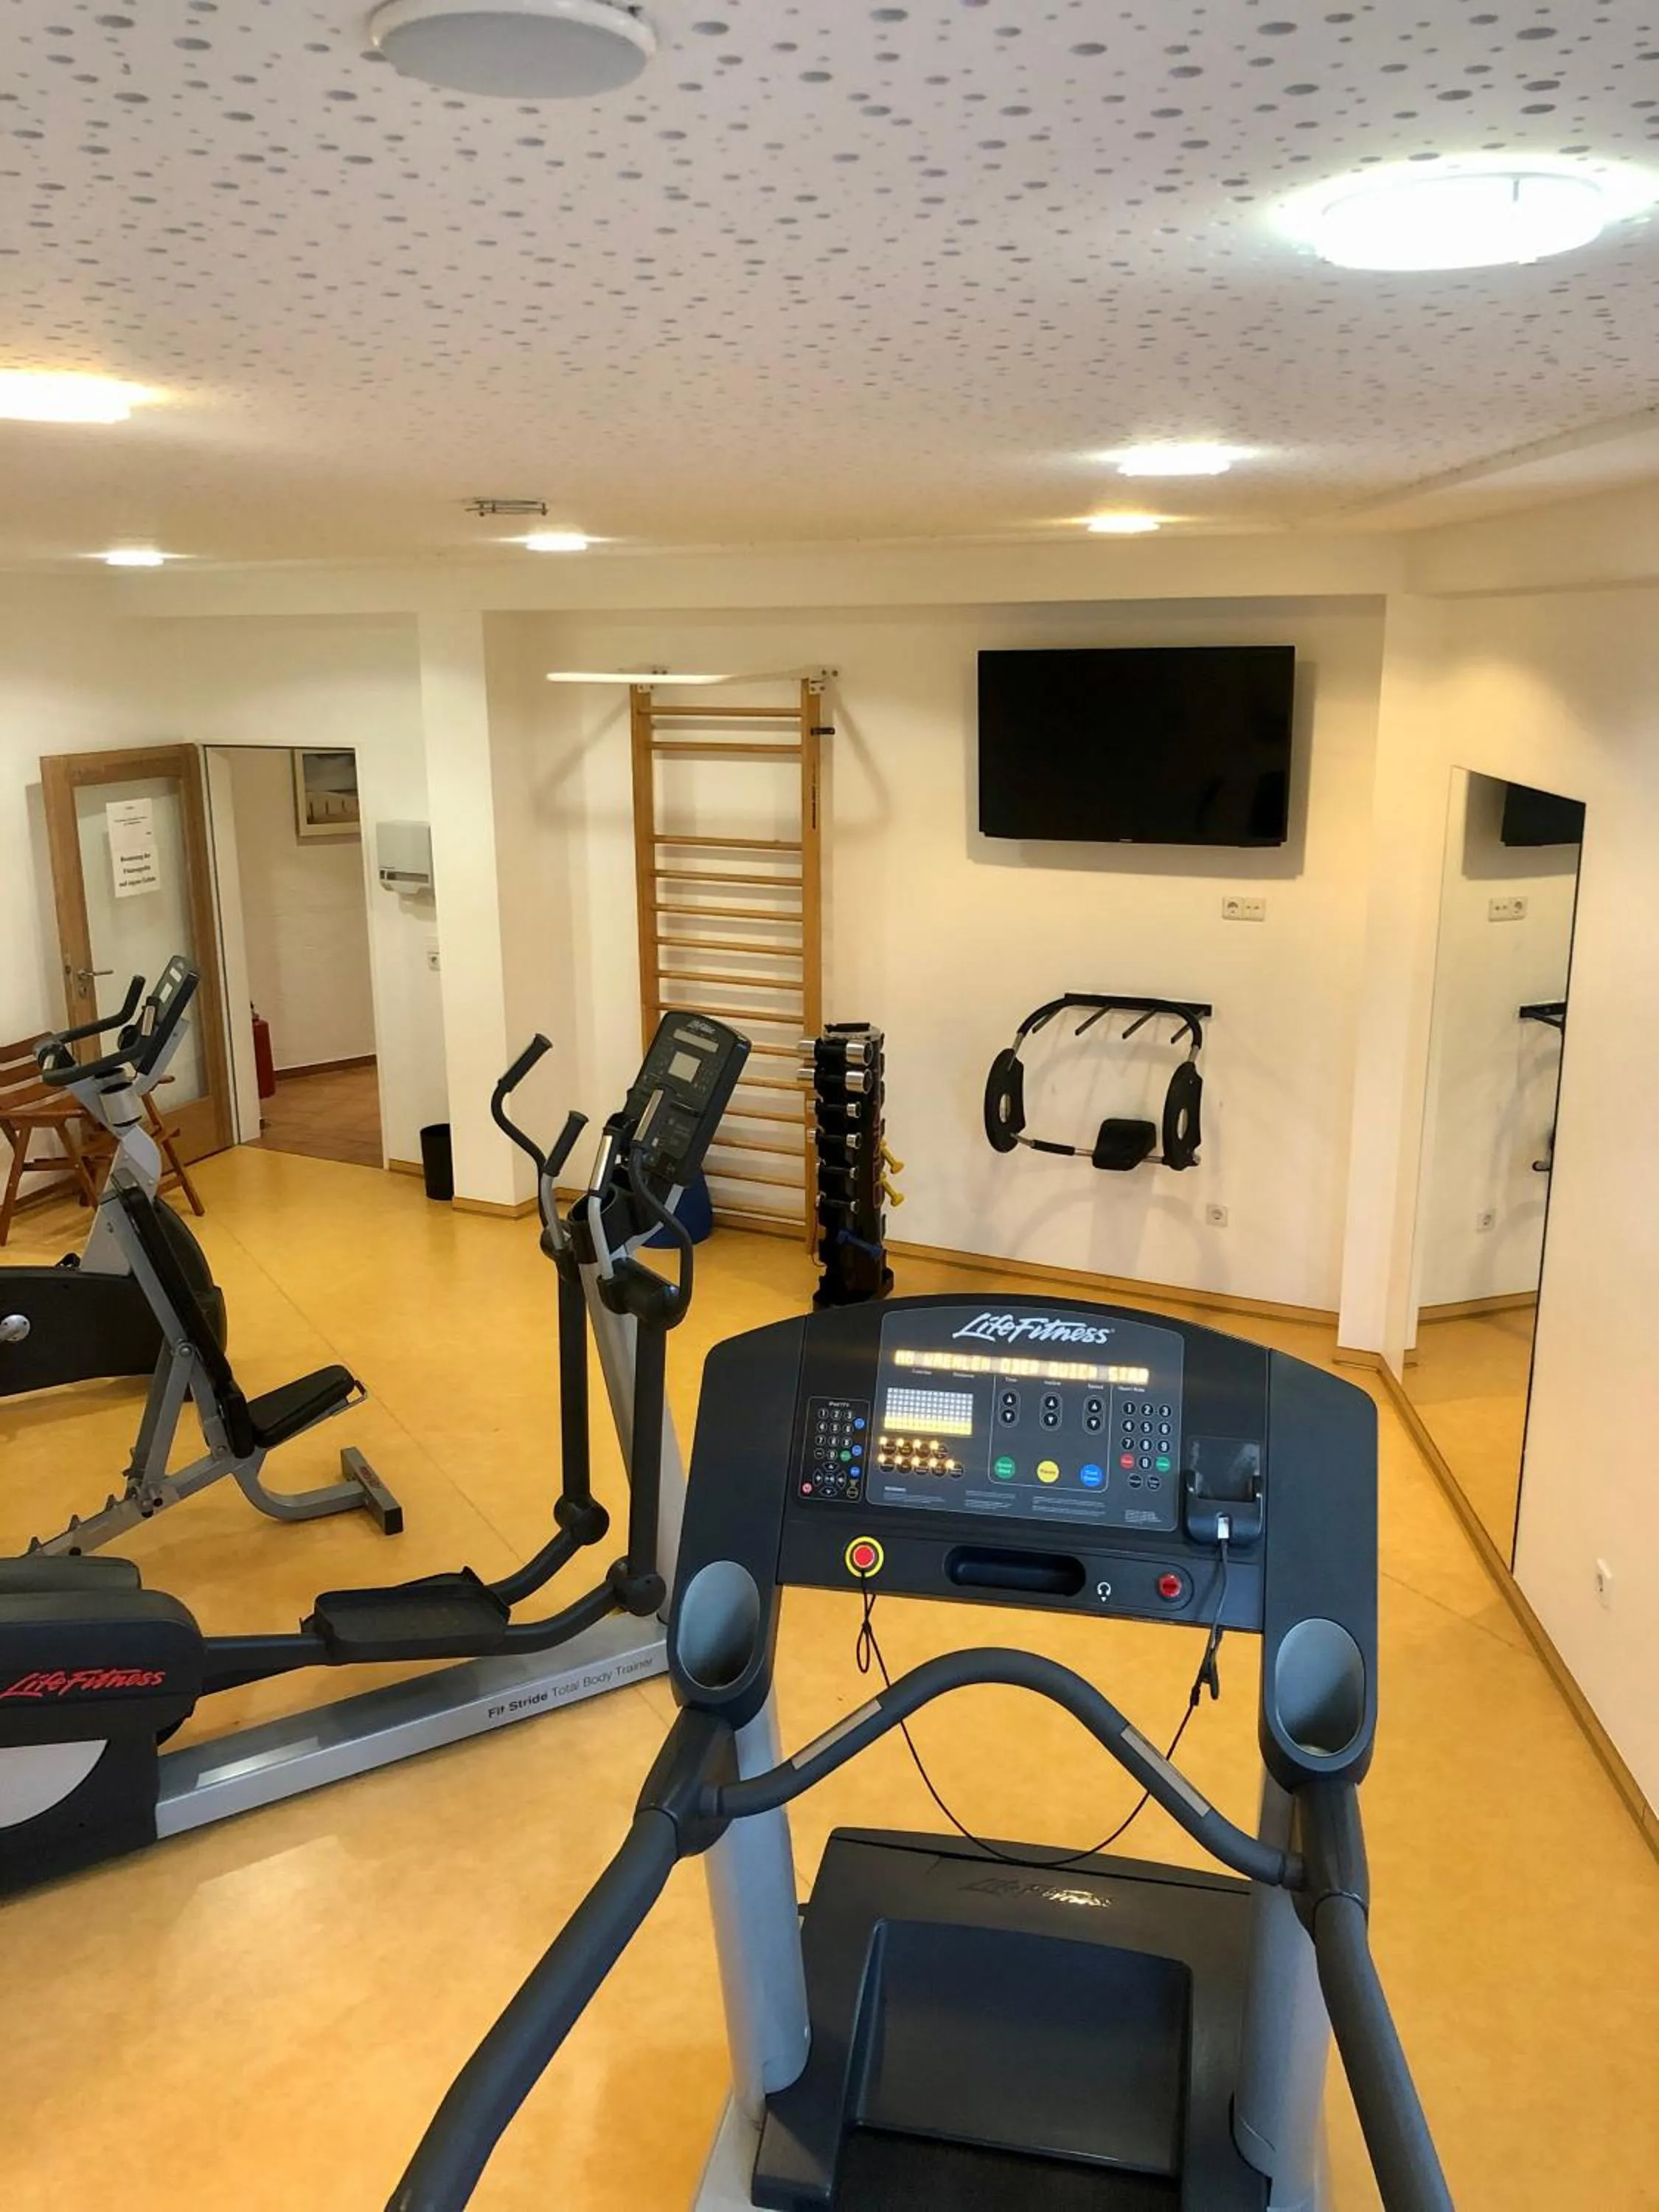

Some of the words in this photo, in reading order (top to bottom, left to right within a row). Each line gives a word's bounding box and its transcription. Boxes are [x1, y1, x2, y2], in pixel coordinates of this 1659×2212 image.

[488, 1705, 504, 1719] Fit
[509, 1691, 548, 1711] Stride
[552, 1680, 580, 1697] Total
[583, 1671, 613, 1688] Body
[616, 1658, 653, 1677] Trainer
